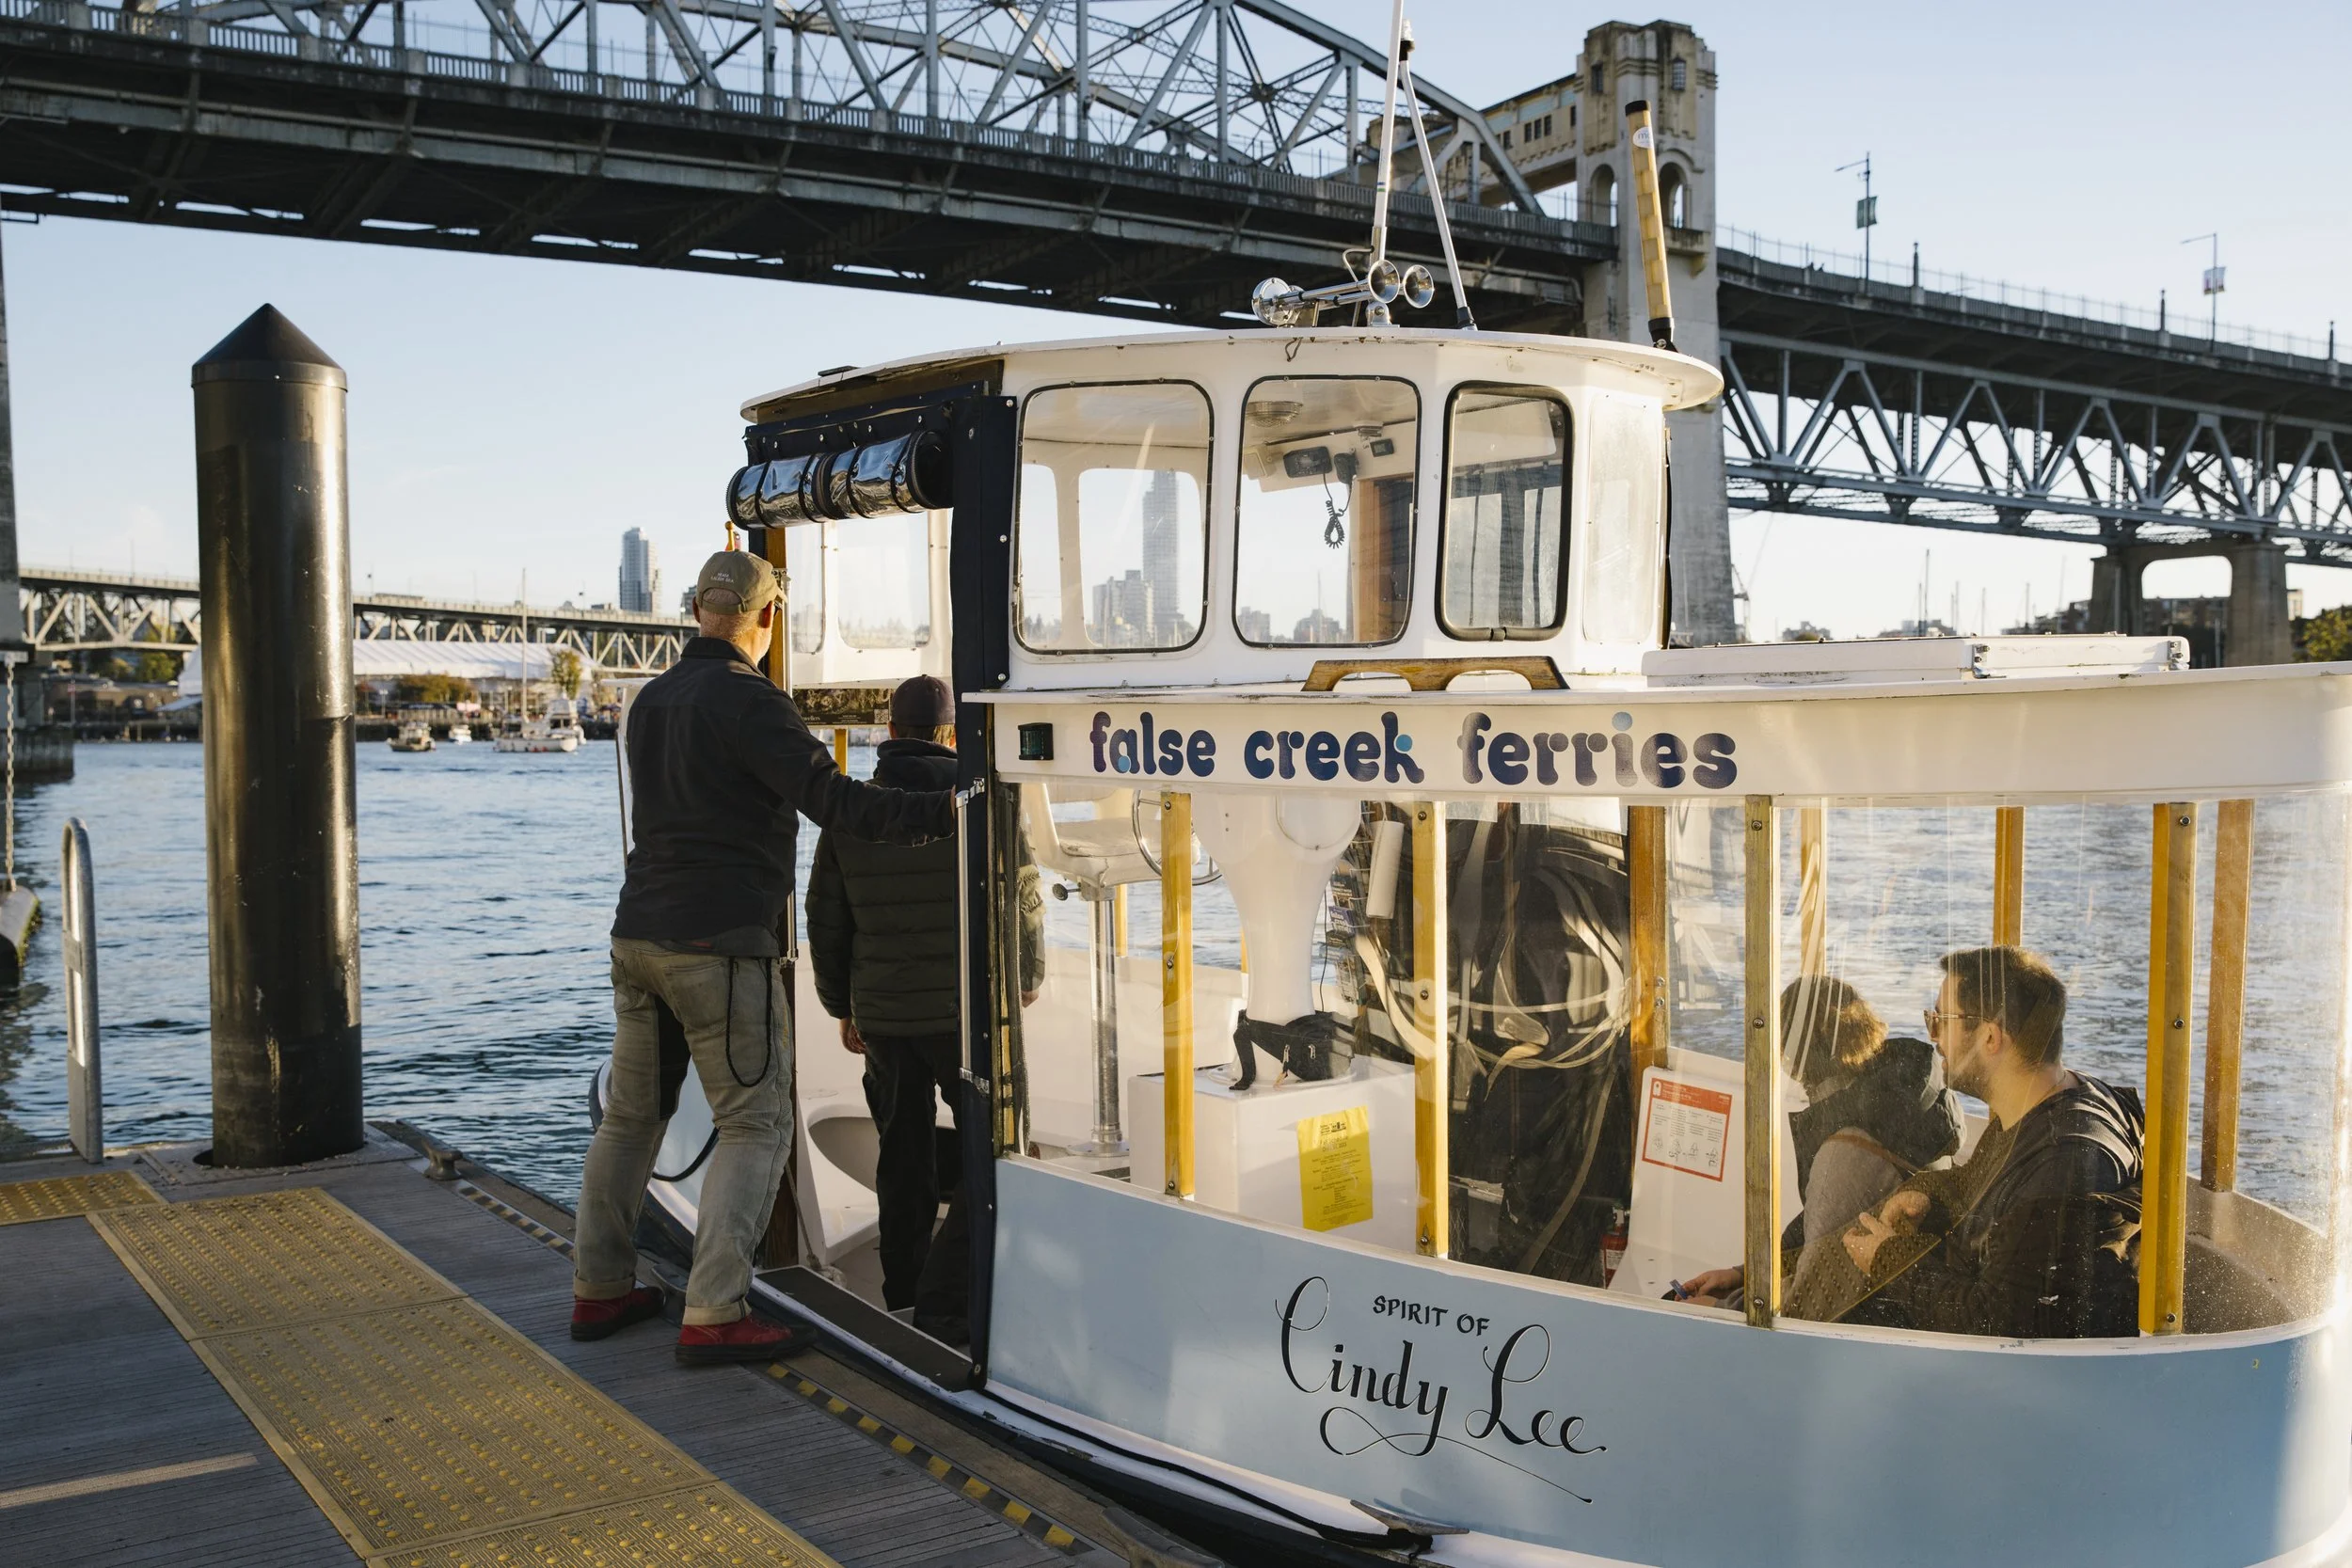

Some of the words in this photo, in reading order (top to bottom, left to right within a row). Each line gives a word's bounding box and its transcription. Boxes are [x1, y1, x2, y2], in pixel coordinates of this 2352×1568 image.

[1089, 710, 1216, 778] false
[1244, 710, 1425, 784] creek
[1457, 711, 1738, 790] ferries
[1373, 1295, 1449, 1327] SPIRIT
[1456, 1313, 1490, 1337] OF
[1275, 1275, 1449, 1457] Cindy
[1465, 1323, 1607, 1455] Lee
